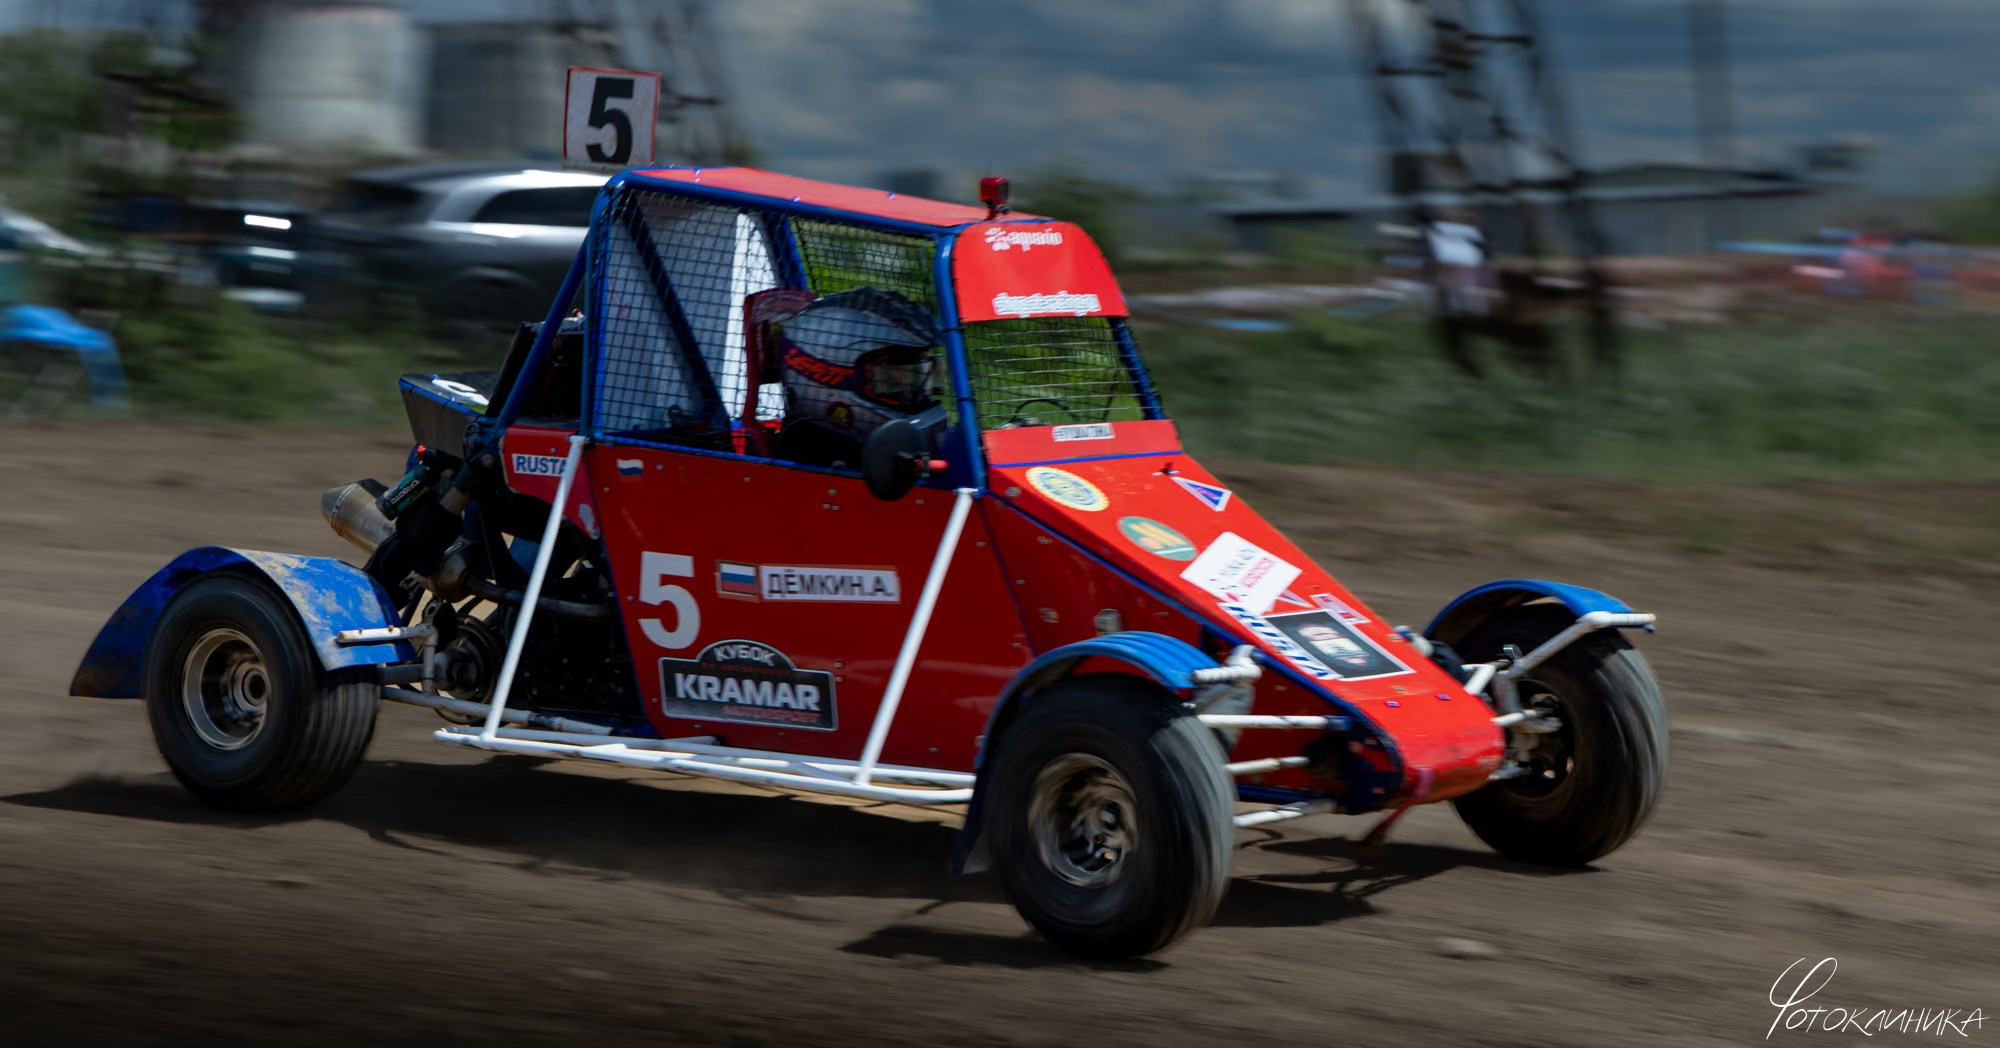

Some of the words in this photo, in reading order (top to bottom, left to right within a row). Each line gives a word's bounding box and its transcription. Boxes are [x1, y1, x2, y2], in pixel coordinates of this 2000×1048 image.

[586, 77, 635, 165] 5
[638, 551, 701, 649] 5
[713, 644, 777, 667] КУБОК
[675, 673, 821, 712] KRAMAR
